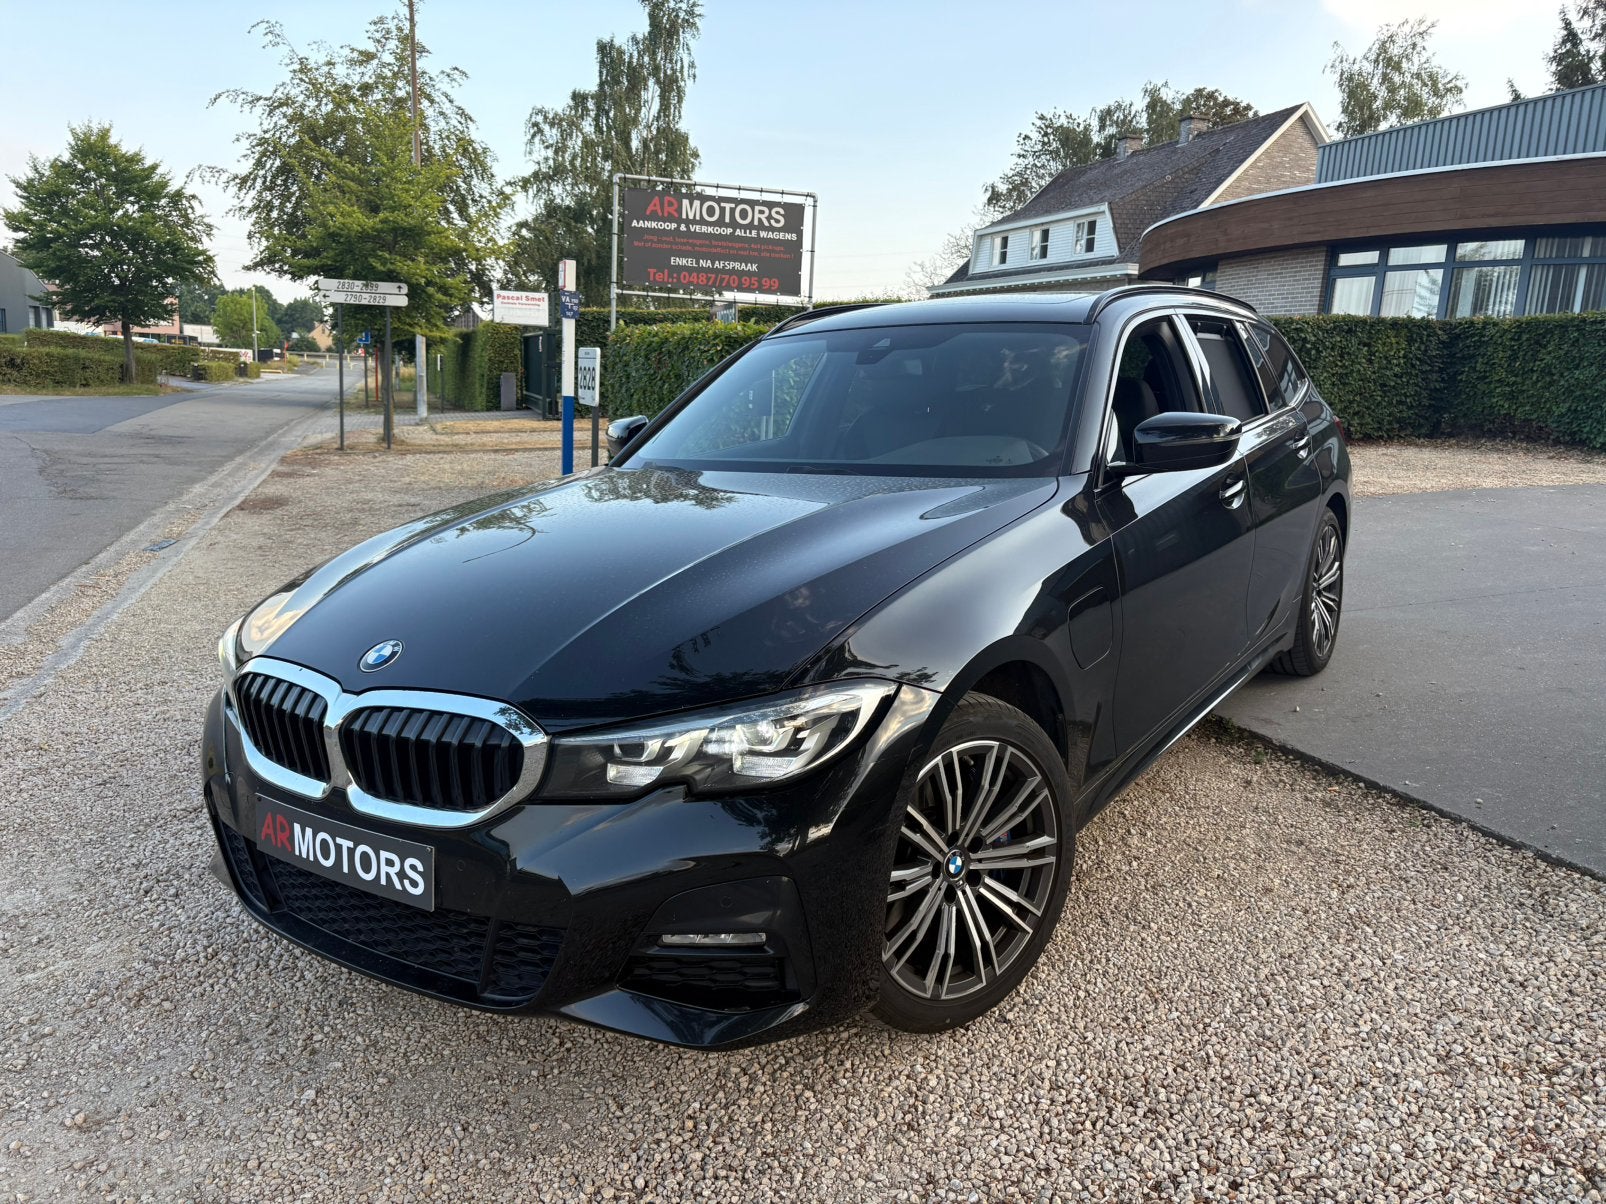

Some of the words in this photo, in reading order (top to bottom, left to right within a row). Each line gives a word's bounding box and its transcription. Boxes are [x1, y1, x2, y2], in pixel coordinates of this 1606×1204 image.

[645, 196, 679, 218] AR
[681, 198, 785, 228] MOTORS
[631, 219, 677, 231] AANKOOP
[680, 223, 687, 232] &
[689, 224, 733, 236] VERKOOP
[735, 228, 758, 238] ALLE
[759, 230, 797, 241] WAGENS
[670, 256, 698, 267] ENKEL
[699, 259, 712, 269] NA
[713, 260, 758, 272] AFSPRAAK
[647, 268, 678, 283] Tel.:
[680, 271, 739, 289] 0487/70
[741, 276, 759, 290] 95
[761, 277, 780, 291] 99
[344, 293, 387, 304] 2790-2829
[496, 293, 523, 301] Pascal
[524, 295, 545, 303] Smet
[579, 366, 596, 391] 2828
[261, 811, 292, 853] AR
[293, 822, 425, 896] MOTORS
